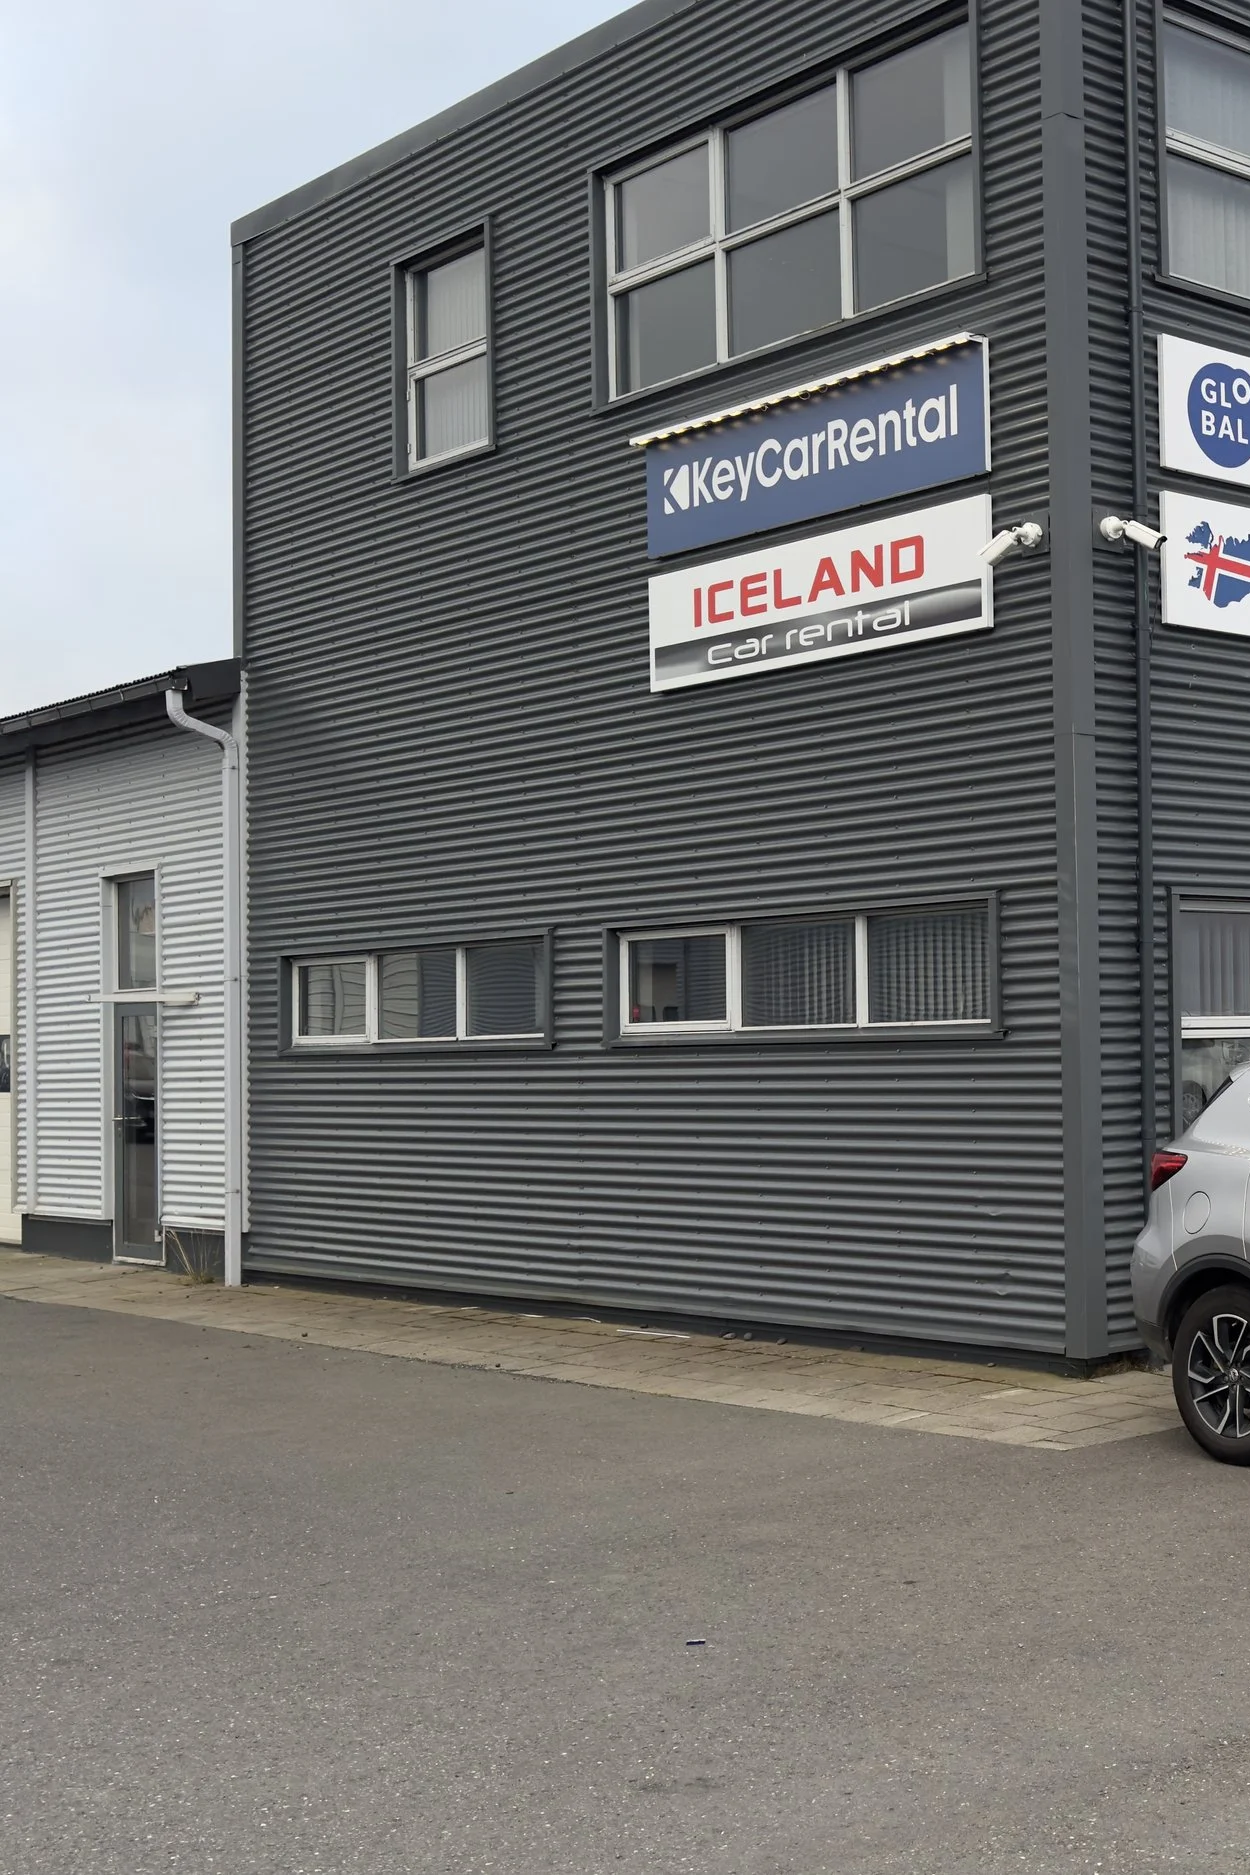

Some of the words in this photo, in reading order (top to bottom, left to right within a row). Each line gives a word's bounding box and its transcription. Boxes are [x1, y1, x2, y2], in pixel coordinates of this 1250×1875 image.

[1200, 377, 1250, 408] GLO
[691, 384, 958, 507] KeyCarRental
[1201, 410, 1249, 444] BAL
[693, 535, 924, 628] ICELAND
[707, 632, 773, 665] car
[785, 600, 910, 651] rental
